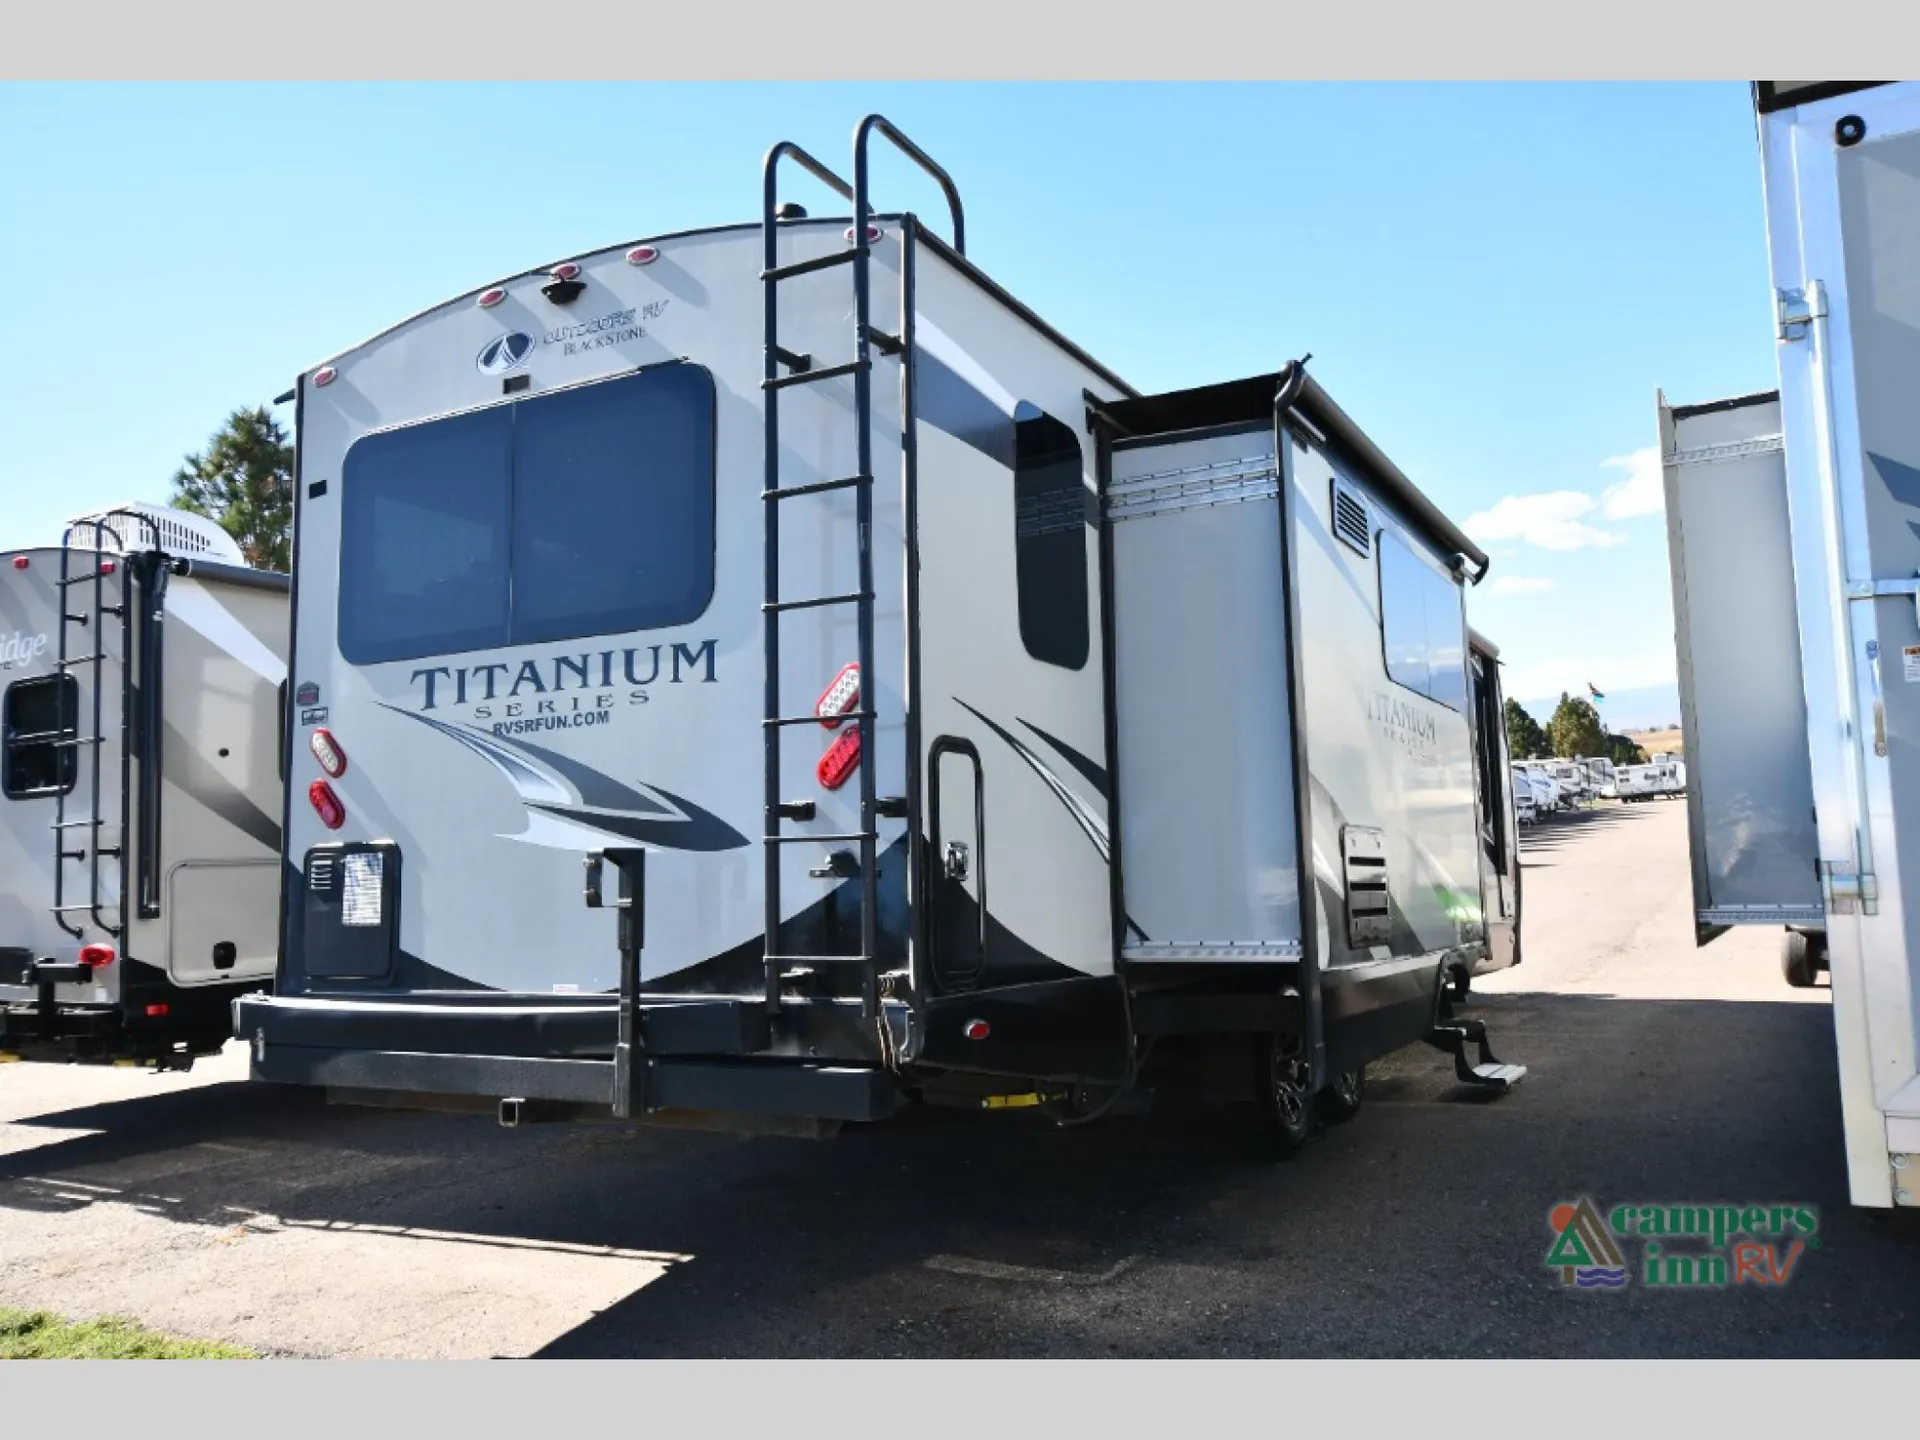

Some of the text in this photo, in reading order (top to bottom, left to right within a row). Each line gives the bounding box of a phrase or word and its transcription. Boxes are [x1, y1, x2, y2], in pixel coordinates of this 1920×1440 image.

[563, 325, 647, 356] BLACKSTONE
[410, 638, 719, 711] TITANIUM
[474, 689, 652, 719] SERIES
[492, 710, 611, 738] RVSRFUN.COM
